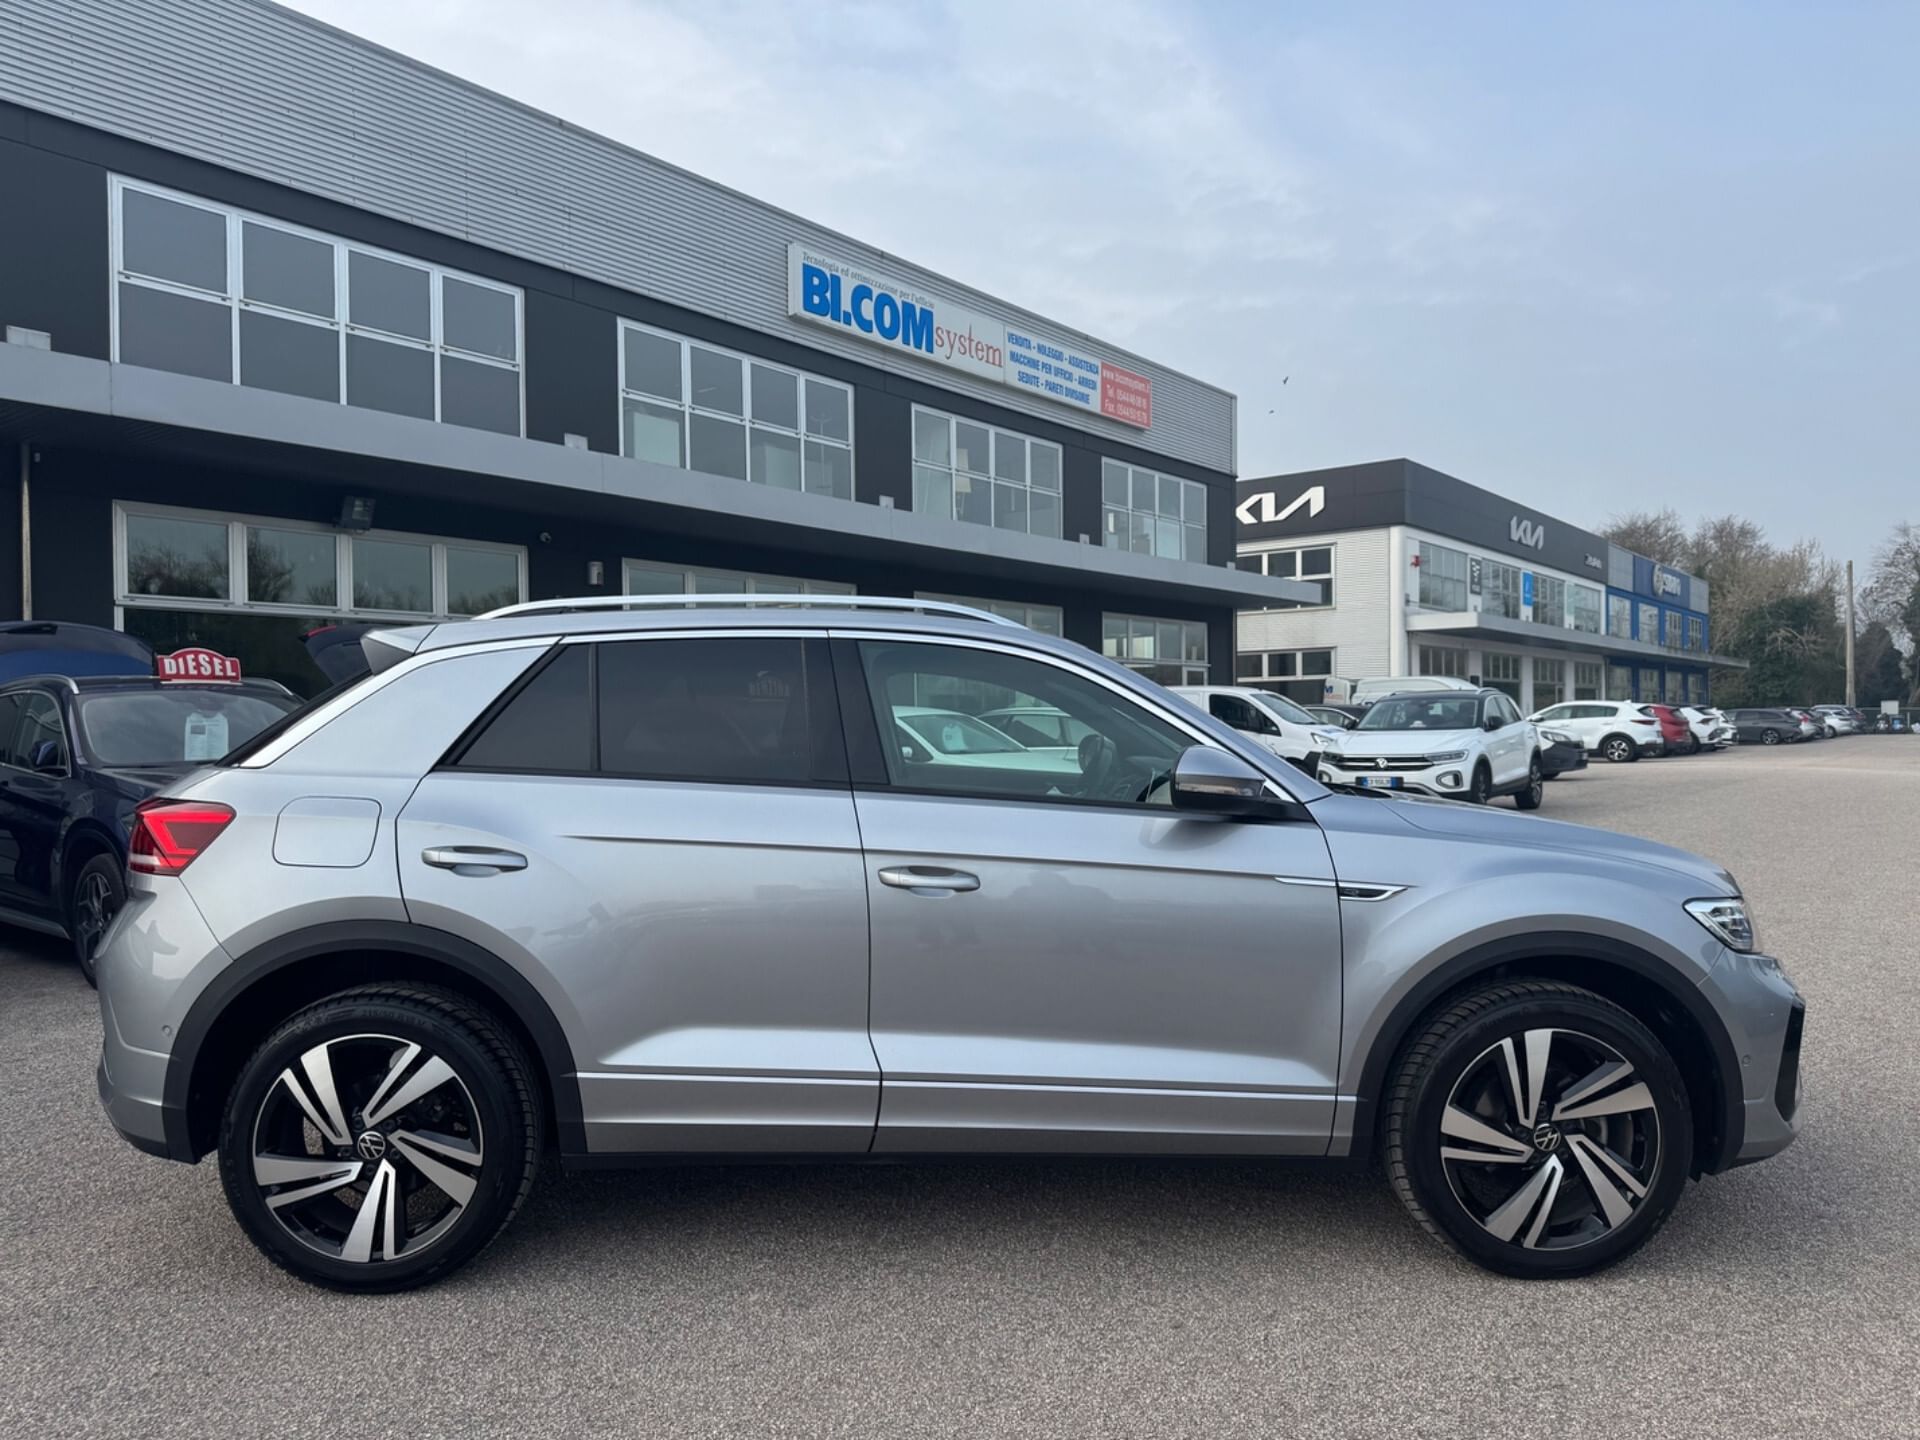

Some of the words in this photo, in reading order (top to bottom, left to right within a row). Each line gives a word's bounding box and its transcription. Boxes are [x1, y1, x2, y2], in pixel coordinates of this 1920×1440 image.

[803, 252, 840, 273] Tecnologia
[840, 267, 849, 277] ed
[899, 289, 910, 300] per
[802, 263, 934, 354] BI.COM
[935, 323, 1003, 368] system
[1007, 330, 1031, 351] VENDITA
[1037, 343, 1064, 362] NOLEGGIO
[1068, 355, 1099, 376] ASSISTENZA
[1009, 350, 1040, 371] MACCHINE
[1041, 361, 1052, 375] PER
[1053, 366, 1073, 383] UFFICIO
[1078, 375, 1097, 391] ARREDI
[1017, 370, 1040, 388] SEDUTE
[1044, 379, 1064, 396] PARETI
[1065, 387, 1090, 405] DIVISORIE
[164, 654, 236, 676] DIESEL
